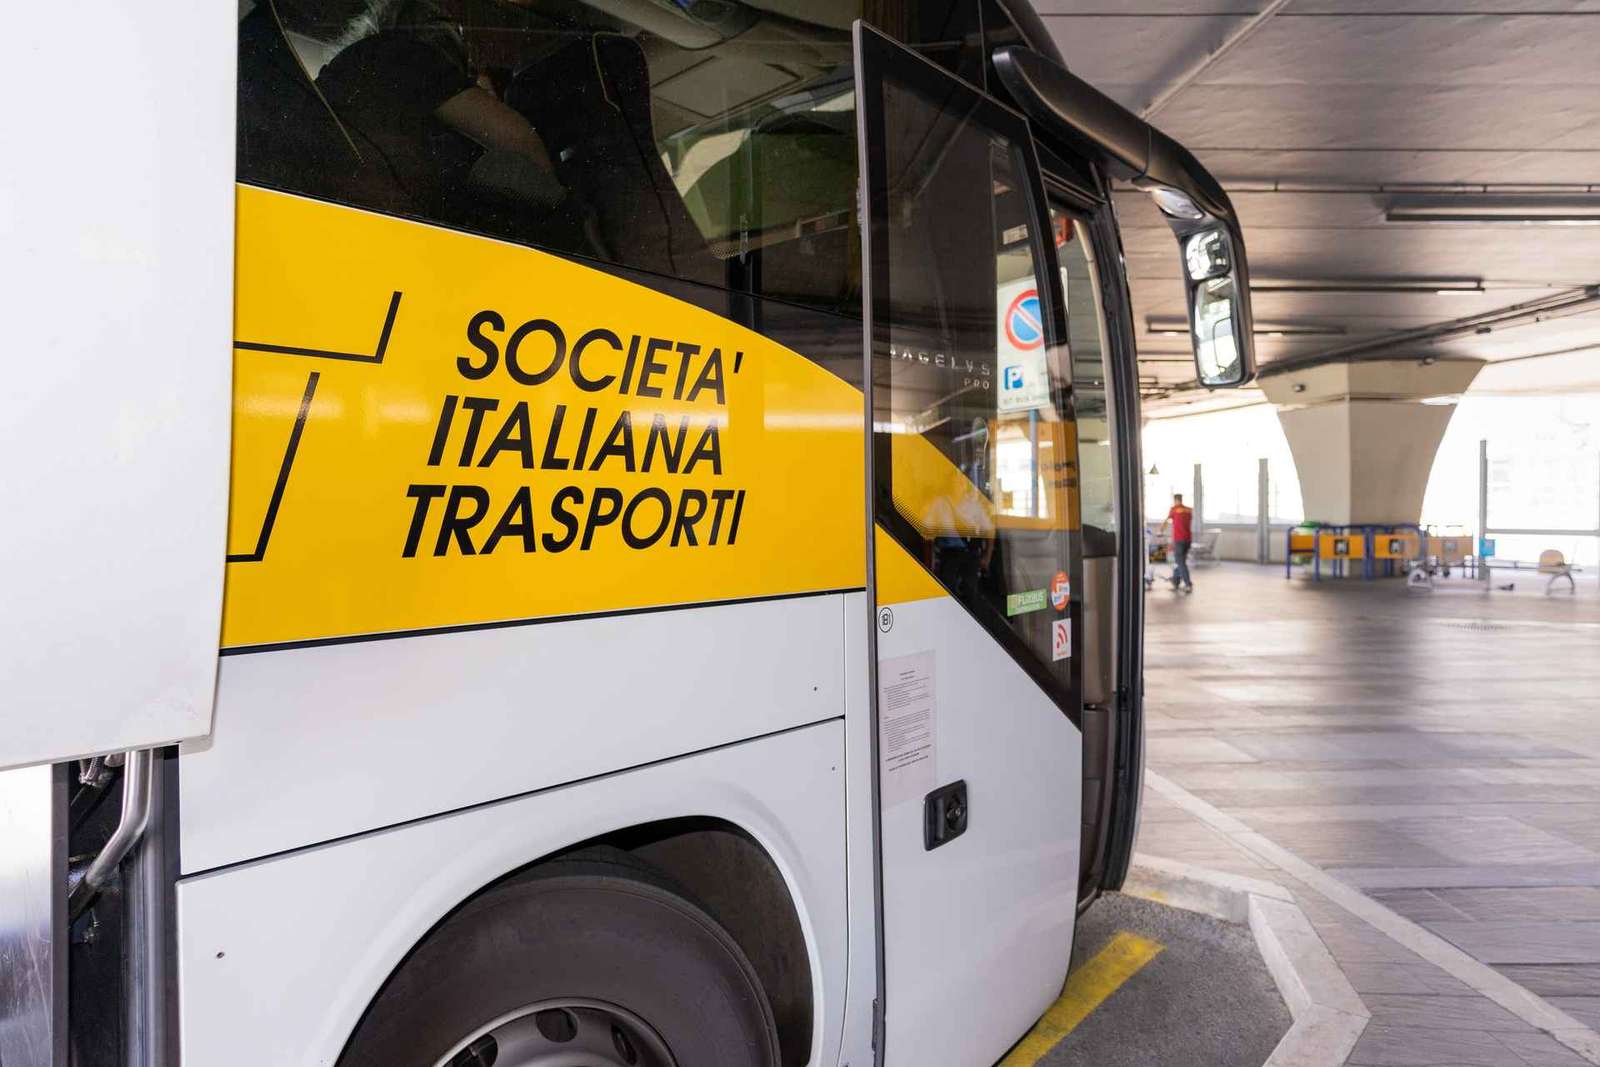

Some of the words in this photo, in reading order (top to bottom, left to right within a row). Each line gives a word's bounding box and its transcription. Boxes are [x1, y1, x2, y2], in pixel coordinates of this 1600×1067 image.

[456, 309, 744, 405] SOCIETA'
[963, 377, 990, 391] PRO
[427, 394, 723, 475] ITALIANA
[401, 484, 746, 558] TRASPORTI
